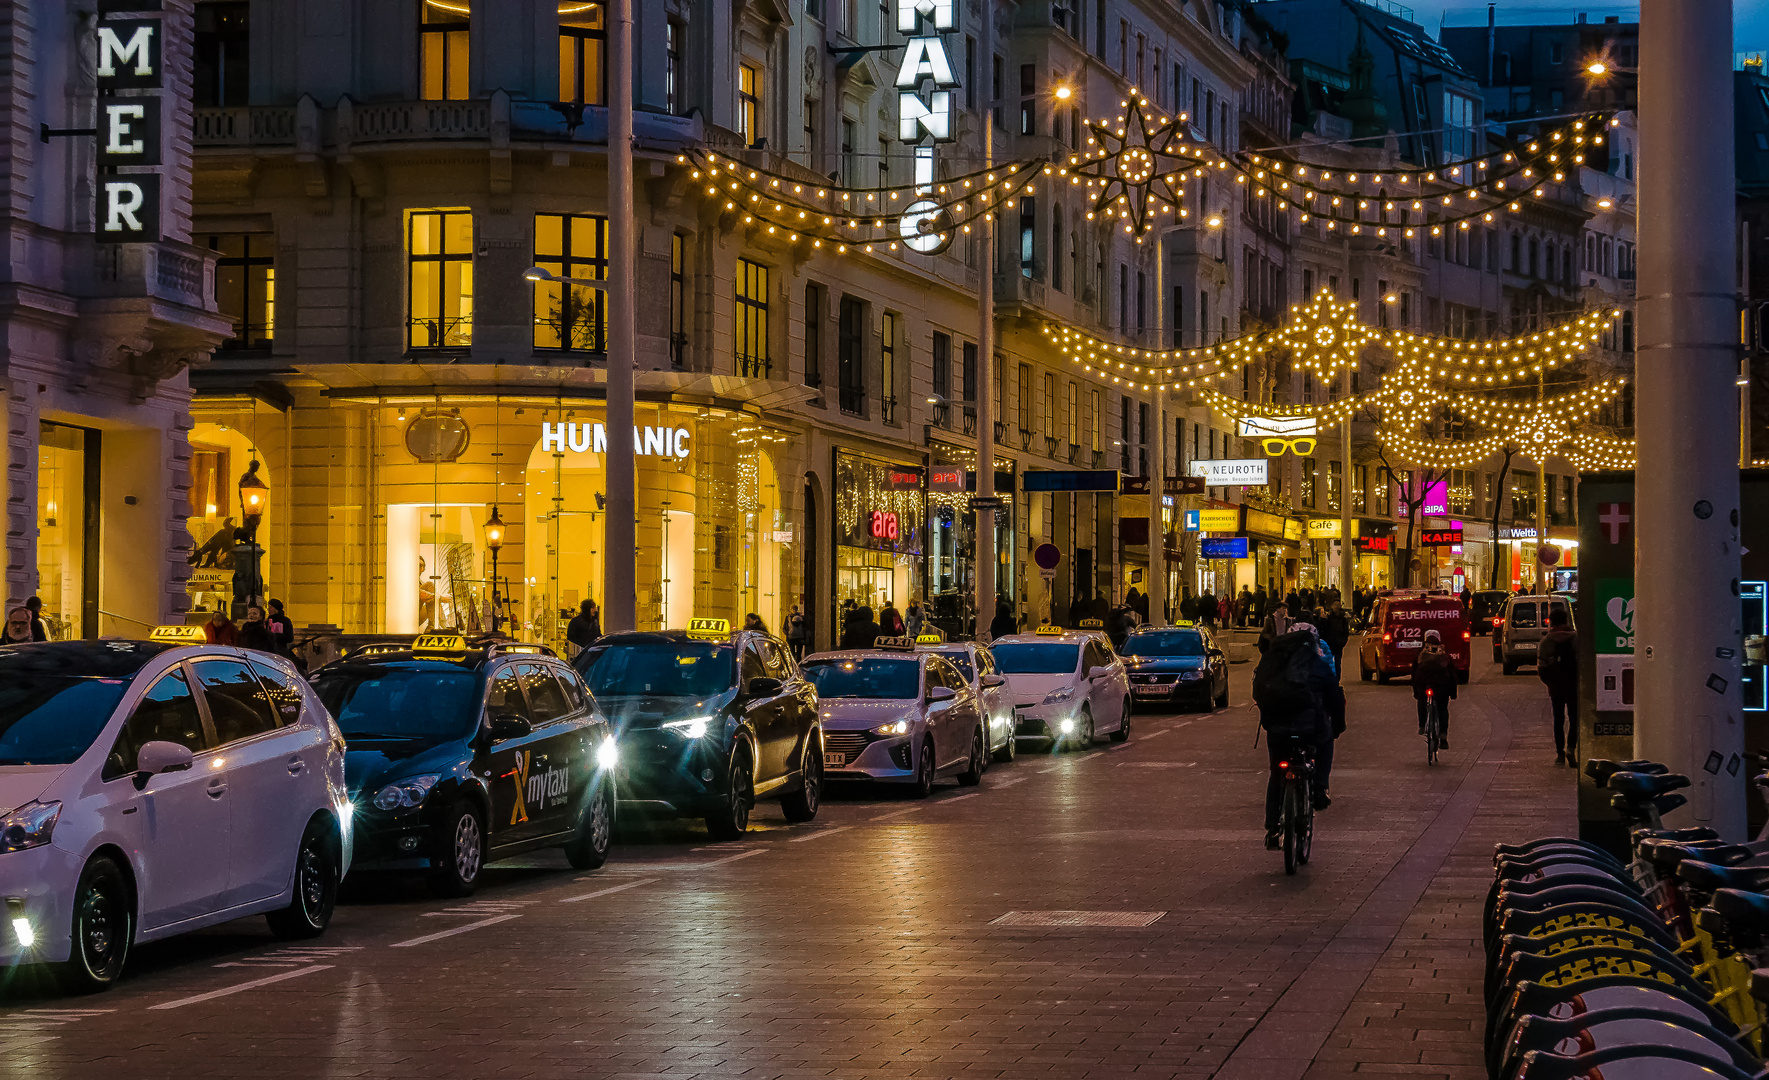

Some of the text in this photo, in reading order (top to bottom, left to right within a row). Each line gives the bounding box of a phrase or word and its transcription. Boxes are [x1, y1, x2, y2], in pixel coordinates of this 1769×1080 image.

[98, 26, 153, 231] MER
[1213, 466, 1263, 474] NEUROTH
[933, 473, 957, 483] ara
[1424, 505, 1445, 514] BIPA
[872, 510, 898, 539] ara
[1187, 513, 1198, 528] L
[1309, 520, 1333, 529] Café
[1423, 533, 1462, 543] KARE
[1393, 610, 1460, 620] FEUERWEHR
[693, 620, 724, 631] TAXI
[158, 627, 196, 636] TAXI
[1402, 628, 1421, 638] 122
[421, 636, 457, 647] TAXI
[879, 637, 910, 646] TAXI
[833, 754, 842, 763] TX
[528, 758, 569, 810] mytaxi
